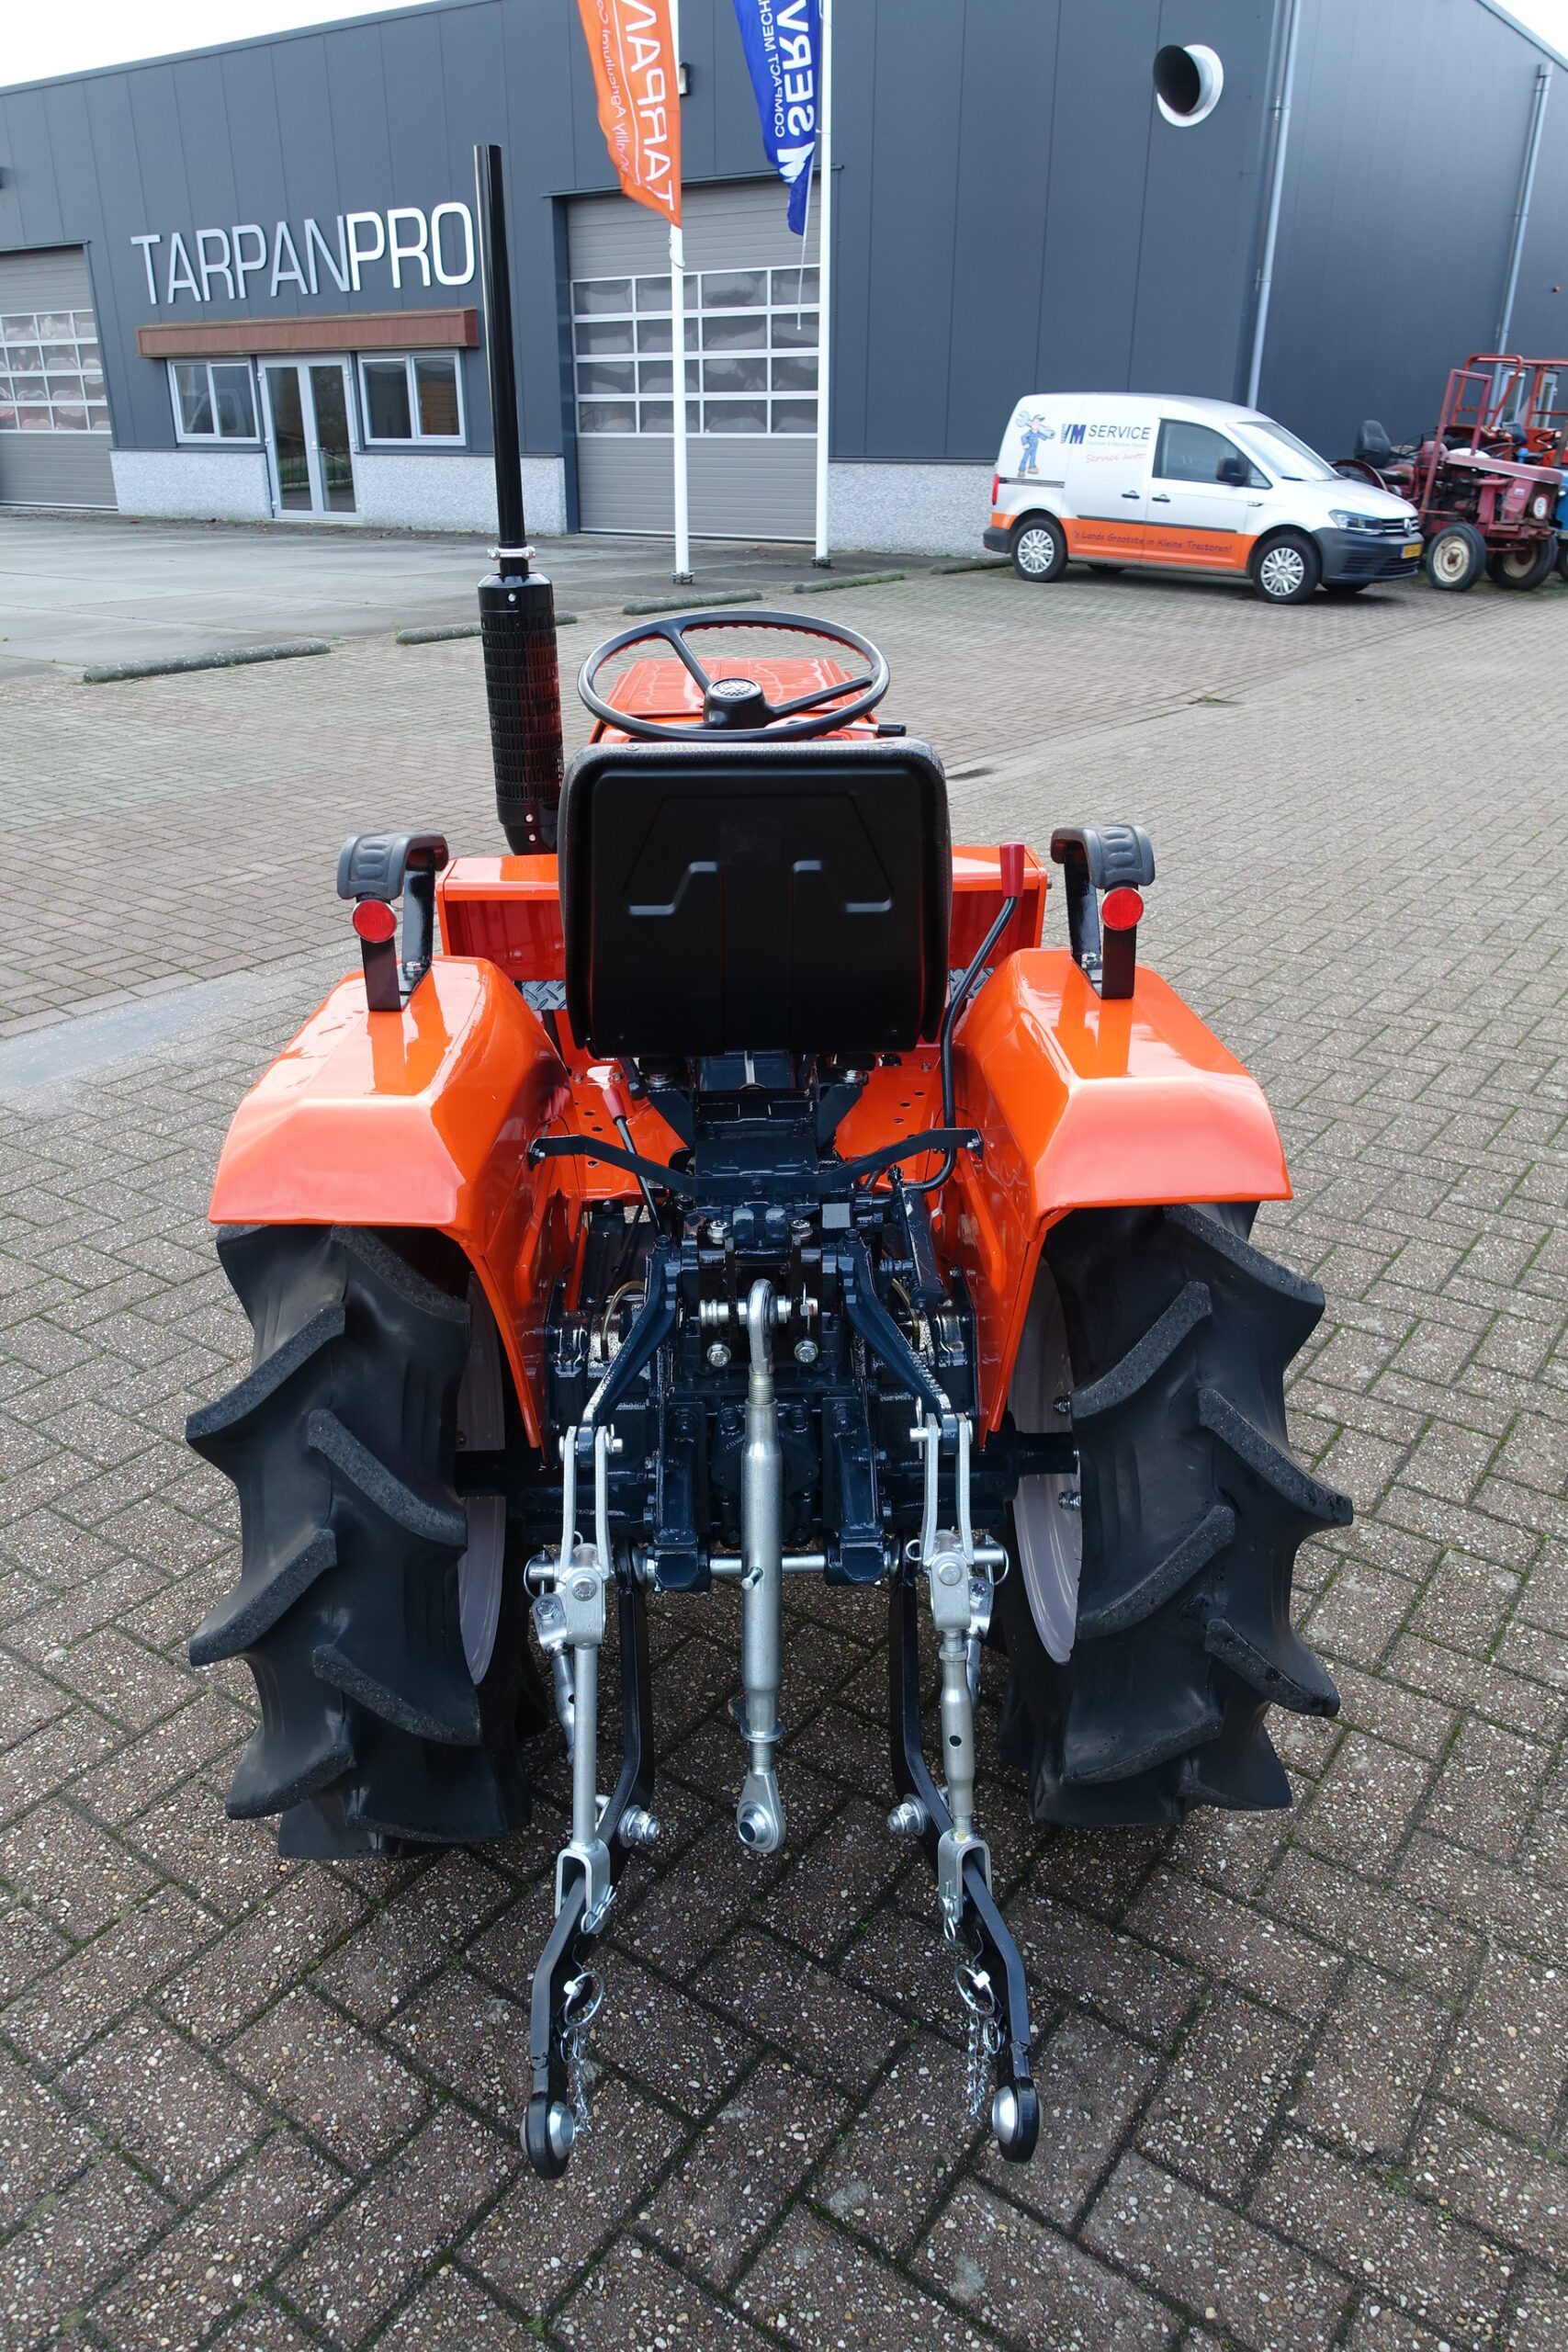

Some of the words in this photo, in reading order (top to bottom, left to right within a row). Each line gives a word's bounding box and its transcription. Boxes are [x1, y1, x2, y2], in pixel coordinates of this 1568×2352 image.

[130, 201, 476, 305] TARPANPRO
[1088, 424, 1152, 440] SERVICE
[1082, 531, 1104, 540] Lands
[1107, 533, 1144, 545] Grootste
[1157, 537, 1183, 549] Kleine
